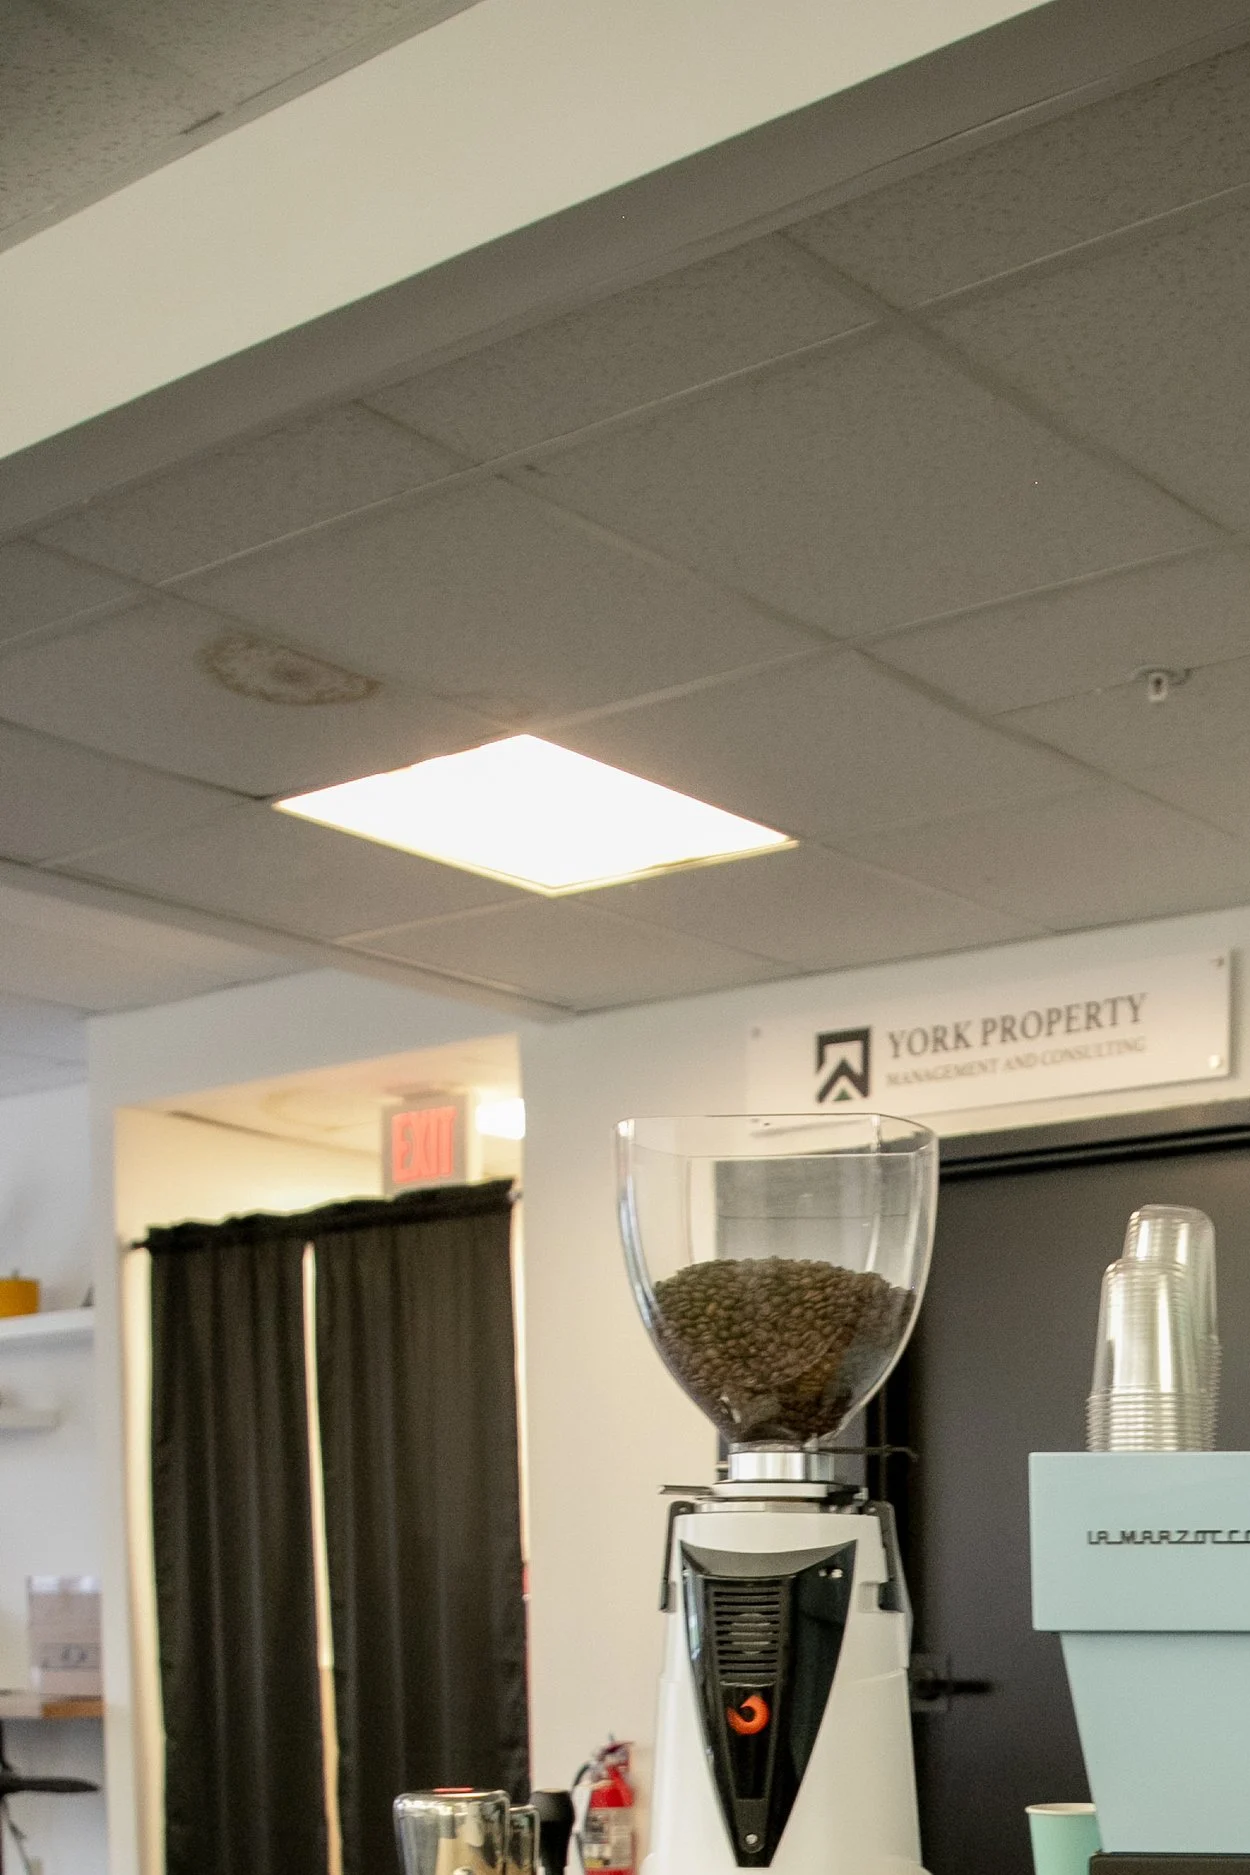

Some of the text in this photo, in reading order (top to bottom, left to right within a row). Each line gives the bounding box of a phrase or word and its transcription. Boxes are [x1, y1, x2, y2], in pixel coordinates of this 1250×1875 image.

[888, 992, 1148, 1059] YORK PROPERTY
[1003, 1051, 1039, 1072] AND
[392, 1106, 457, 1184] EXIT
